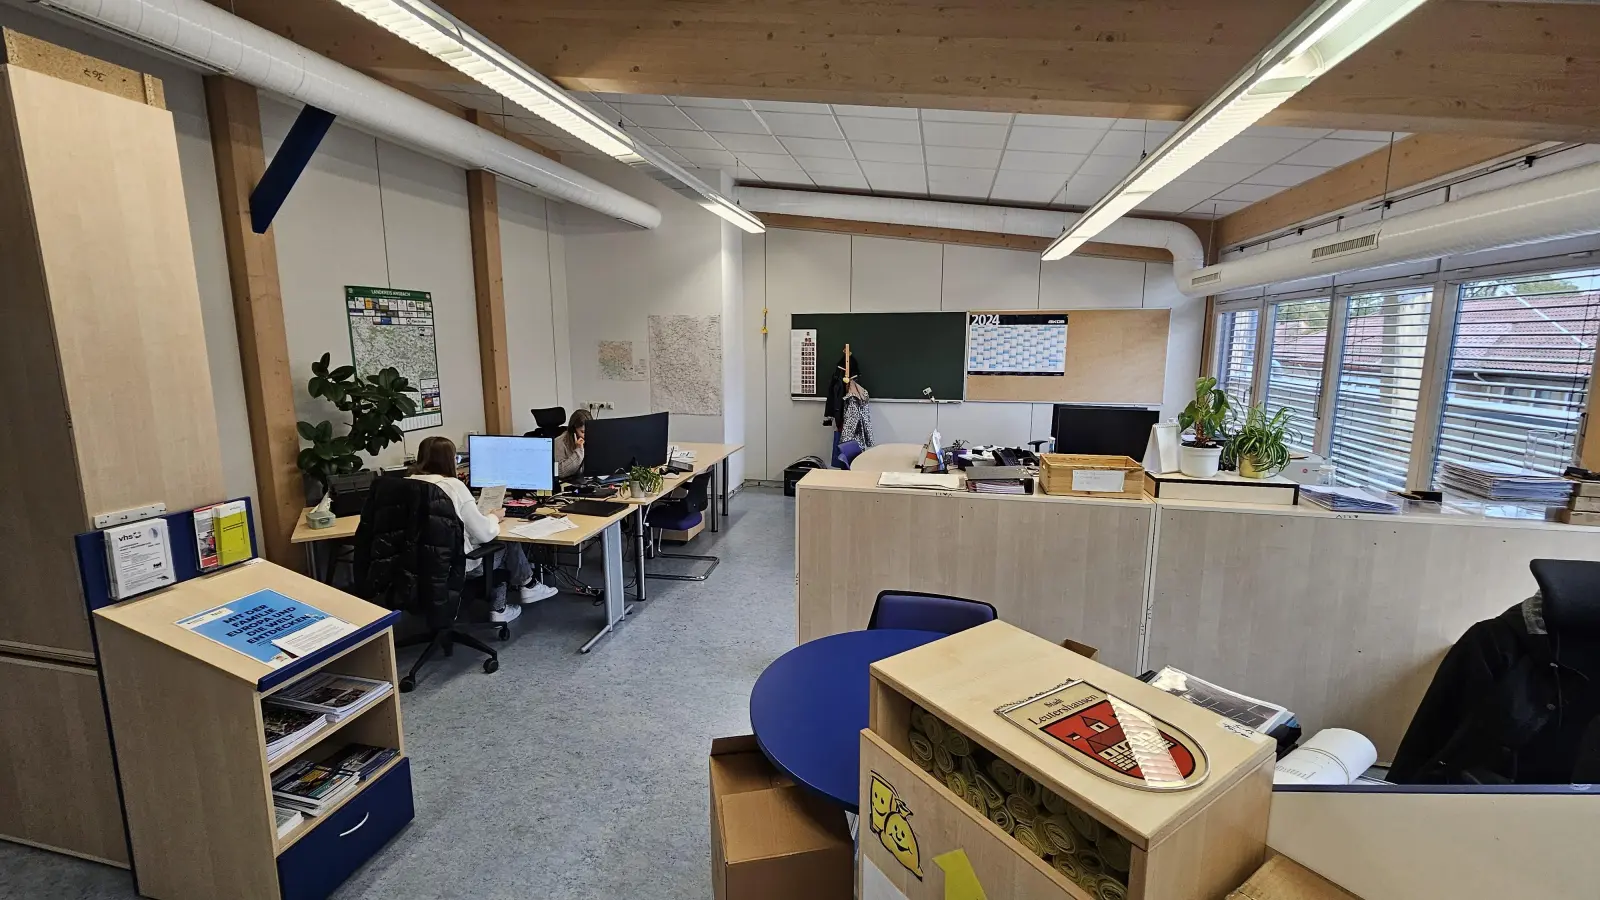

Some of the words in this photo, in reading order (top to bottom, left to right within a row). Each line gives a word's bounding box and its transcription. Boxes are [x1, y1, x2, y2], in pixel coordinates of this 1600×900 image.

[971, 314, 1001, 325] 2024
[118, 533, 134, 542] vhs
[223, 613, 244, 624] MIT
[244, 604, 269, 615] DER
[226, 617, 274, 638] EUROPA
[271, 606, 297, 618] UND
[232, 608, 277, 628] FAMILIE
[246, 627, 268, 637] DIE
[265, 613, 295, 628] WELT
[246, 615, 312, 644] ENTDECKEN
[1027, 694, 1099, 726] Leutershausen
[1043, 698, 1065, 708] Stadt
